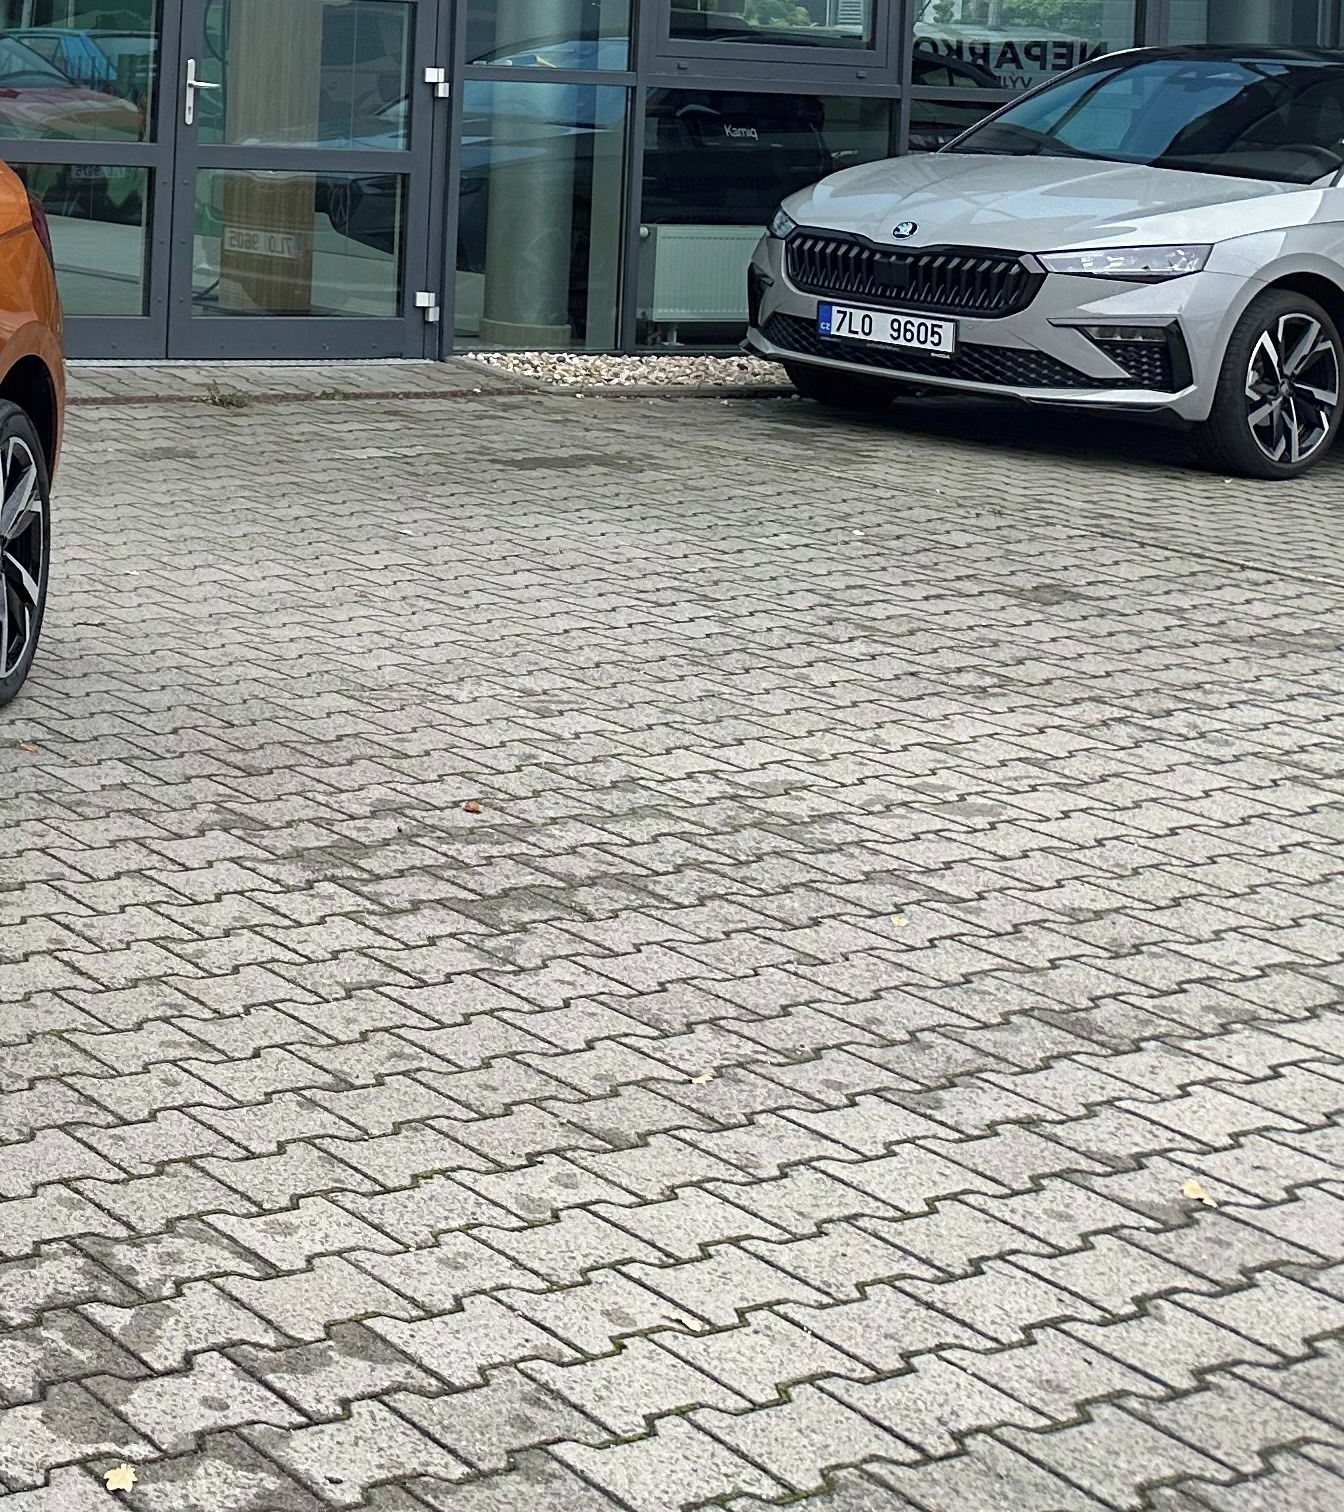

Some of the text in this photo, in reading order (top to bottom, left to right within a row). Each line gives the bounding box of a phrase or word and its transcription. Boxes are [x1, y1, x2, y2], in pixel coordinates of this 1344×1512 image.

[820, 309, 943, 347] CZ 7L0 9605
